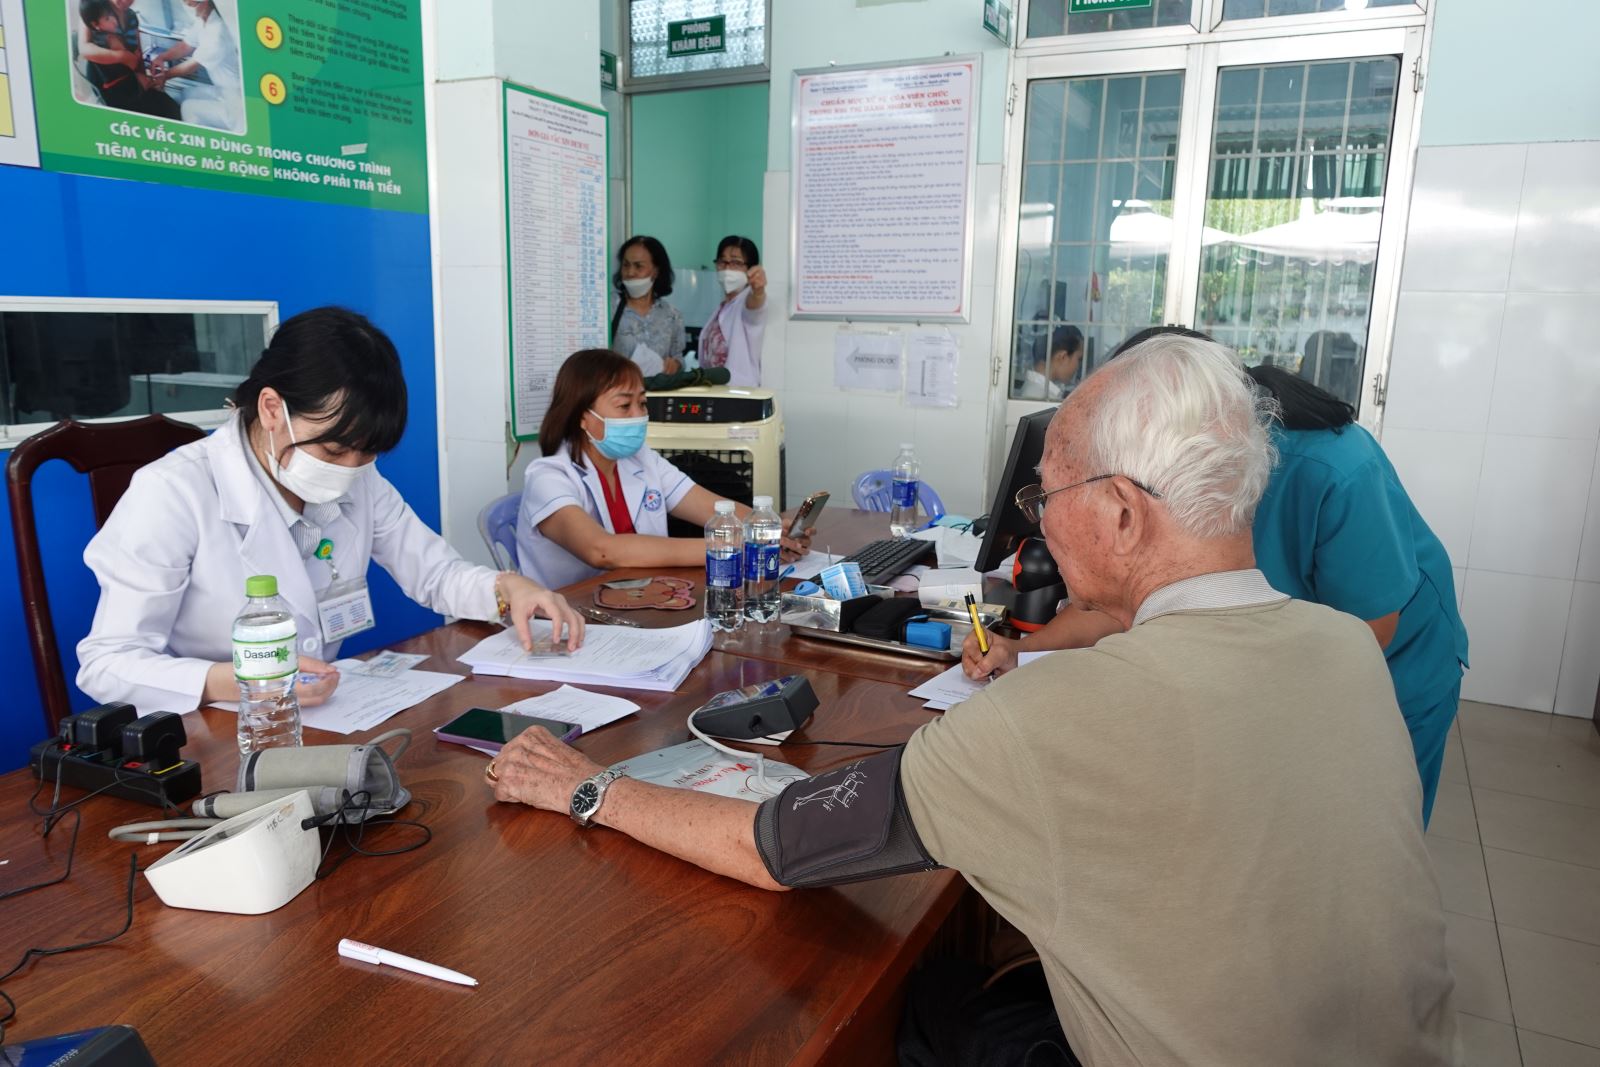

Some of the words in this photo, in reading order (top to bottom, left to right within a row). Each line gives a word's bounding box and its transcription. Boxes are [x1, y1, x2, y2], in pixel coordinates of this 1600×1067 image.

[265, 25, 274, 41] 5
[269, 82, 278, 97] 6
[109, 121, 141, 138] CÁC
[145, 124, 176, 144] VẮC
[179, 132, 206, 148] XIN
[210, 137, 254, 155] DÙNG
[256, 145, 302, 162] TRONG
[305, 153, 356, 171] CHƯƠNG
[358, 161, 392, 177] TRÌNH
[95, 141, 137, 159] TIÊM
[141, 147, 197, 167] CHỦNG
[201, 155, 225, 171] MỞ
[229, 160, 270, 177] RỘNG
[273, 167, 320, 184] KHÔNG
[323, 173, 351, 188] PHẢI
[352, 177, 375, 192] TRẢ
